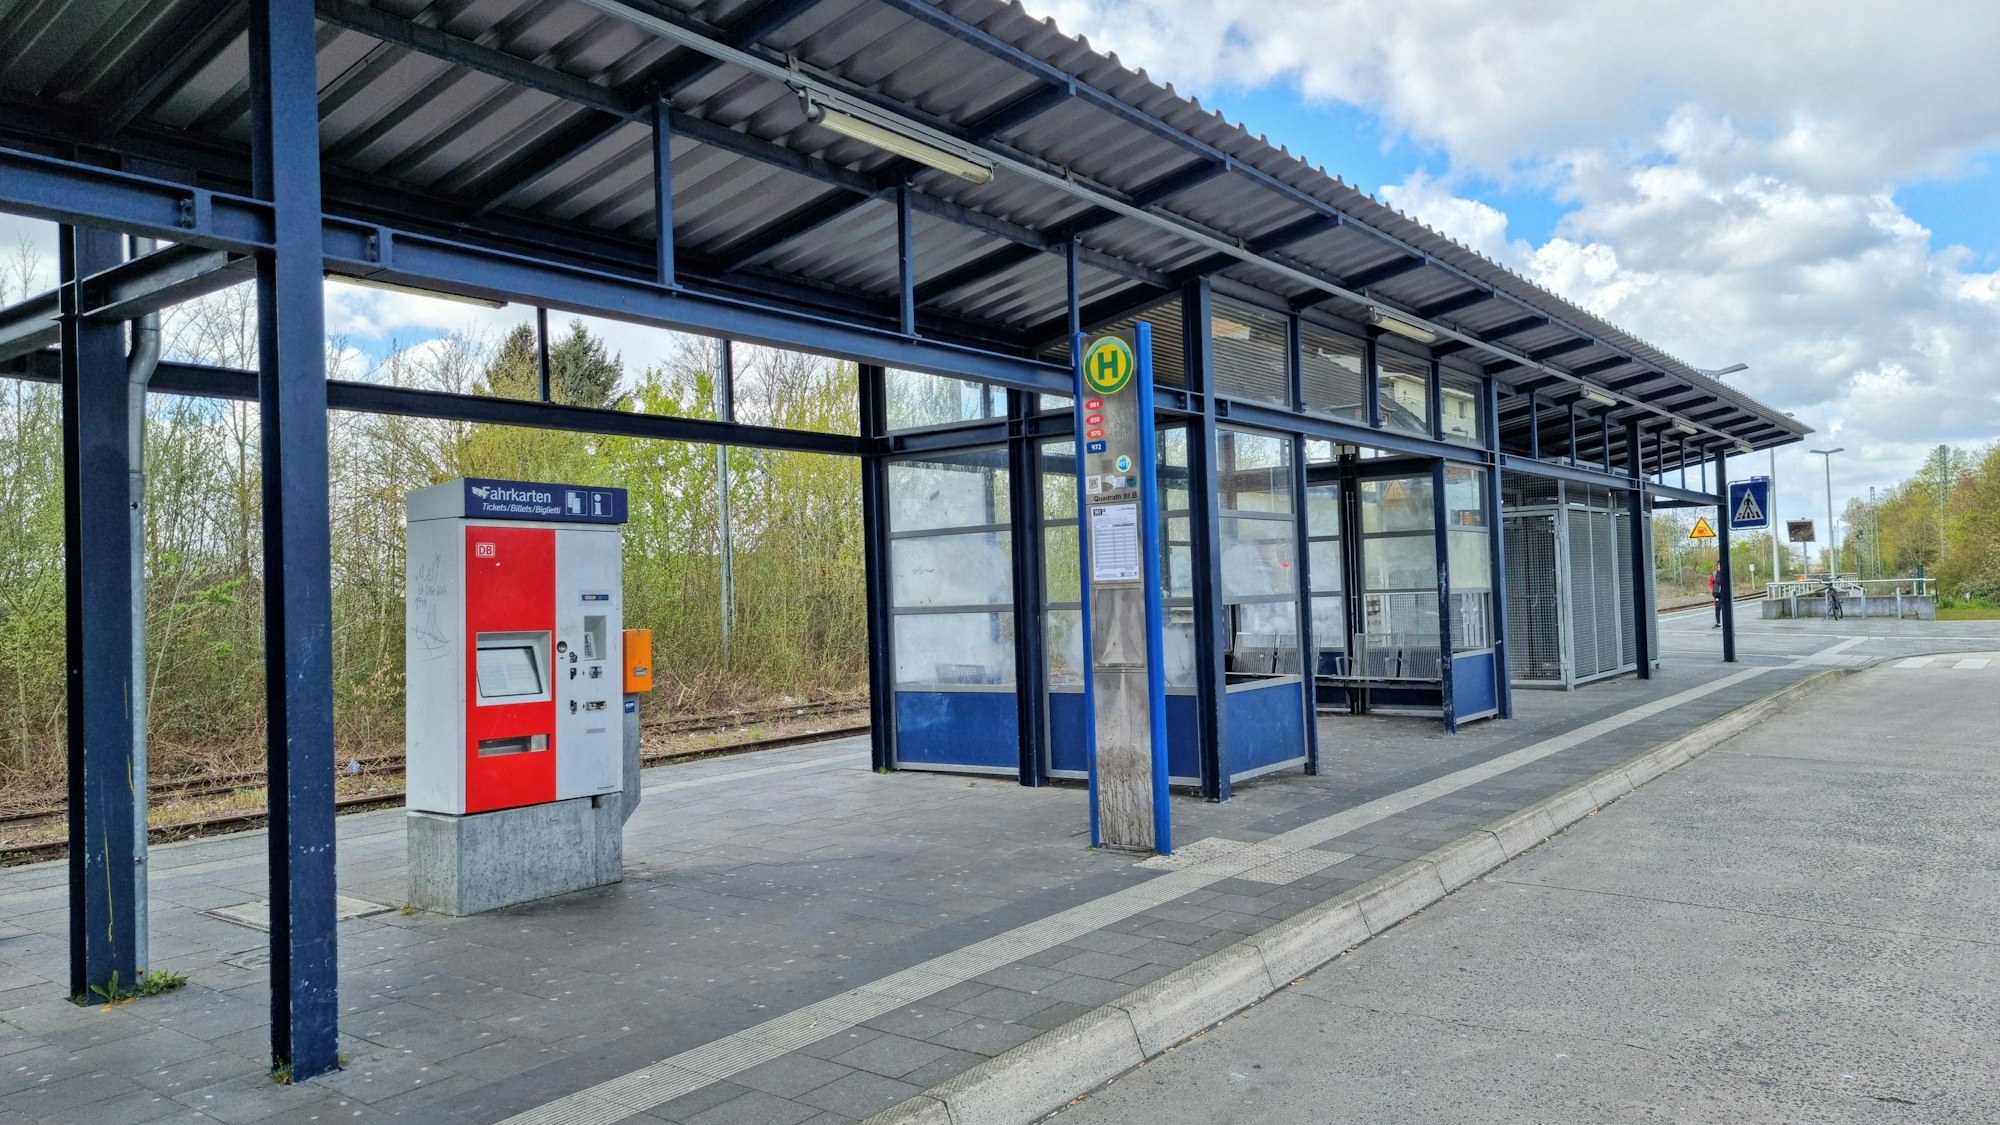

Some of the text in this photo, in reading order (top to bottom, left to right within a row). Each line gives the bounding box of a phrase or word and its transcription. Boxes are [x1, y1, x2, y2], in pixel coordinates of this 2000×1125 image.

[1097, 351, 1119, 380] H
[1090, 416, 1101, 424] 950
[1091, 430, 1102, 438] 970
[480, 486, 552, 503] Fahrkarten
[1093, 493, 1122, 502] Quadrath
[477, 545, 493, 555] DB
